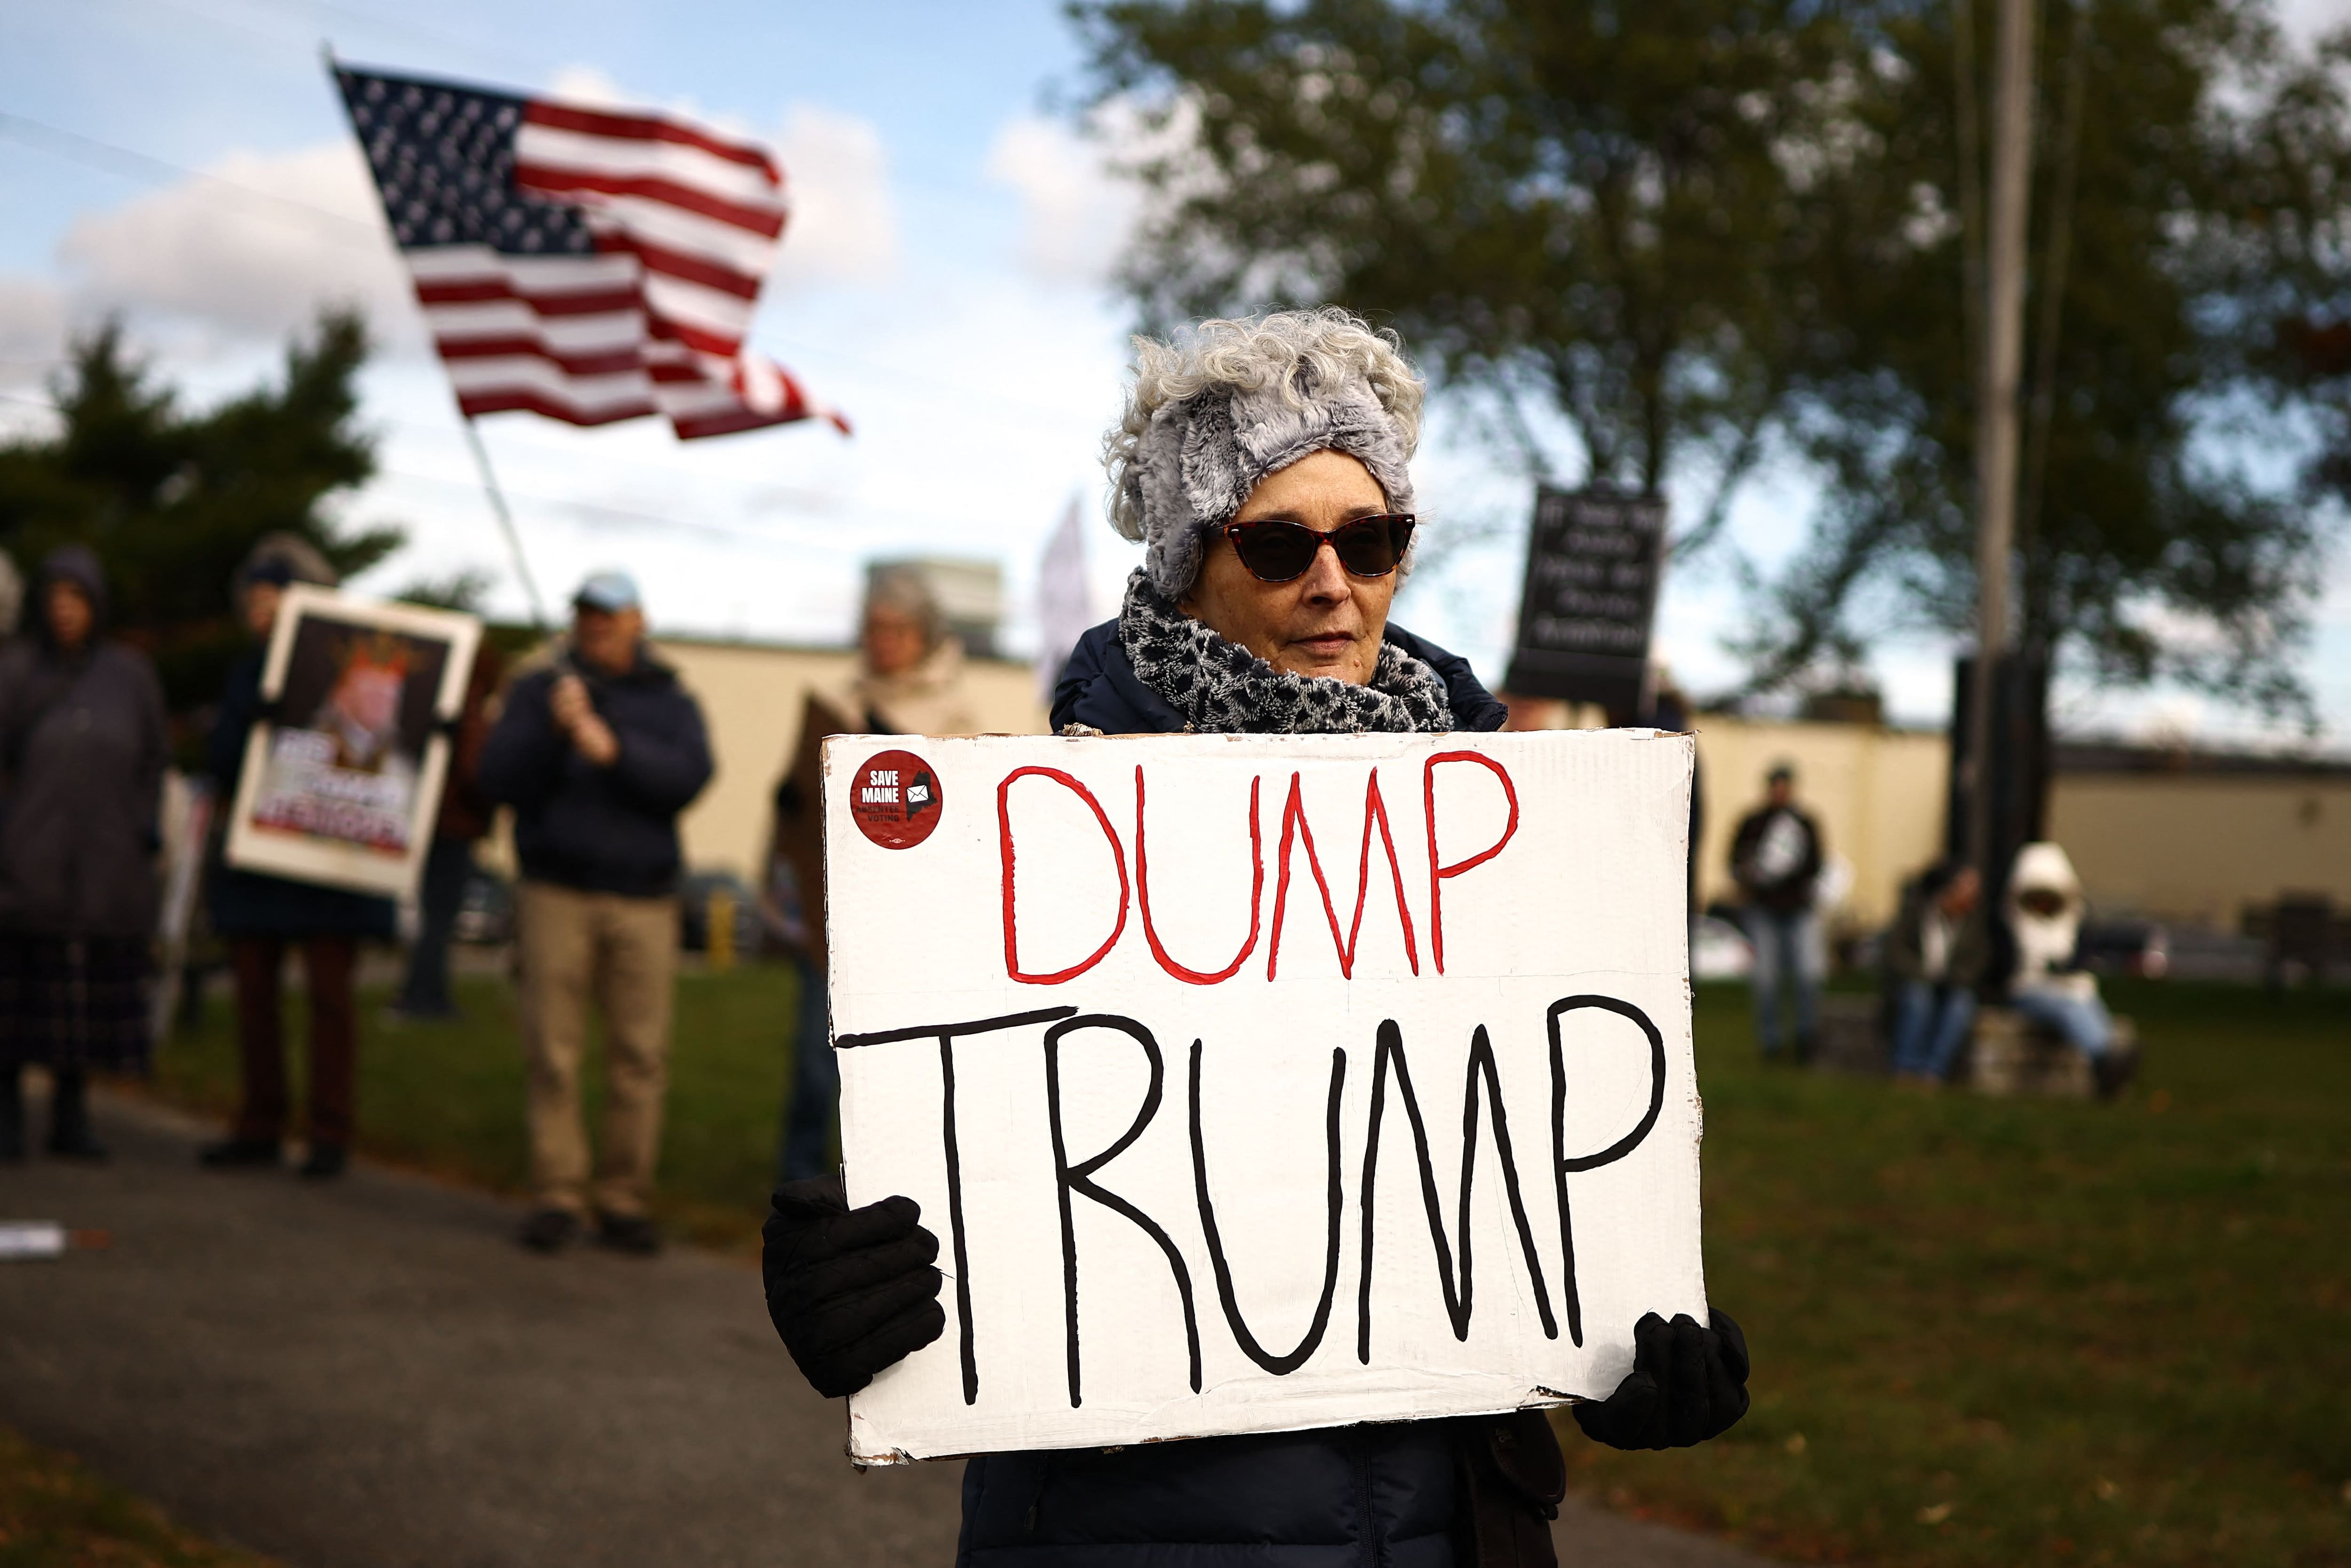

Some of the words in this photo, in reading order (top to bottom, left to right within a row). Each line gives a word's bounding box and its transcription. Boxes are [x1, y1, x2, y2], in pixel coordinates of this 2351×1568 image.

[862, 788, 899, 803] MAINE
[870, 770, 899, 786] SAVE
[997, 750, 1519, 985] DUMP
[835, 994, 1666, 1408] TRUMP
